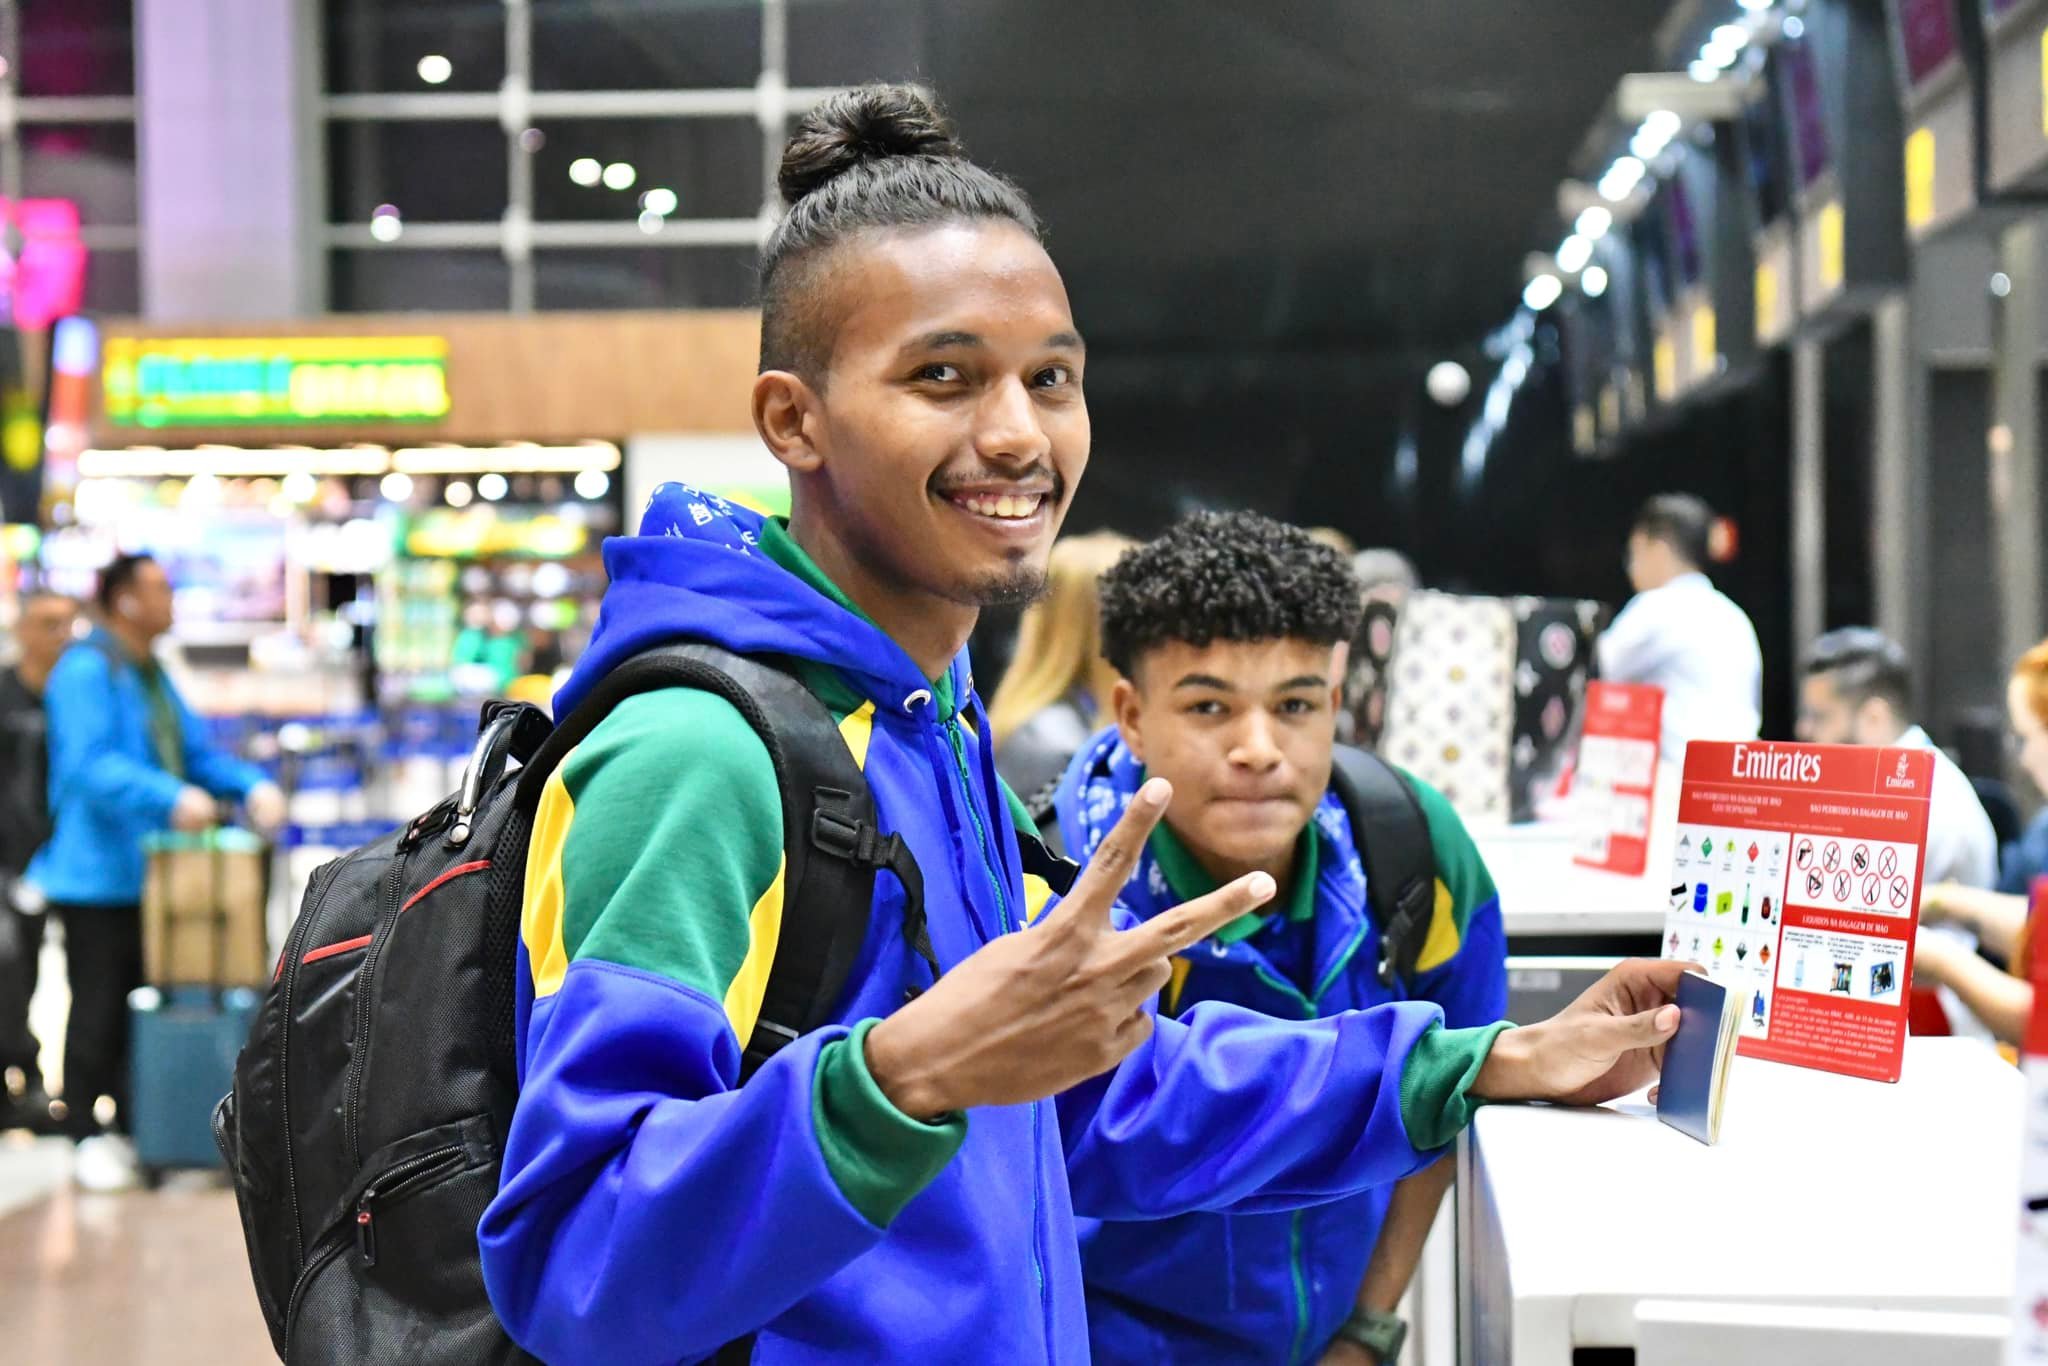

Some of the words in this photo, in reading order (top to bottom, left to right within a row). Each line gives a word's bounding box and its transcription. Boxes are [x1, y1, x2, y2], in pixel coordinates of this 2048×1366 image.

[1732, 743, 1821, 783] Emirates
[1886, 776, 1915, 788] Emirates
[1838, 918, 1866, 930] BAGAGEM
